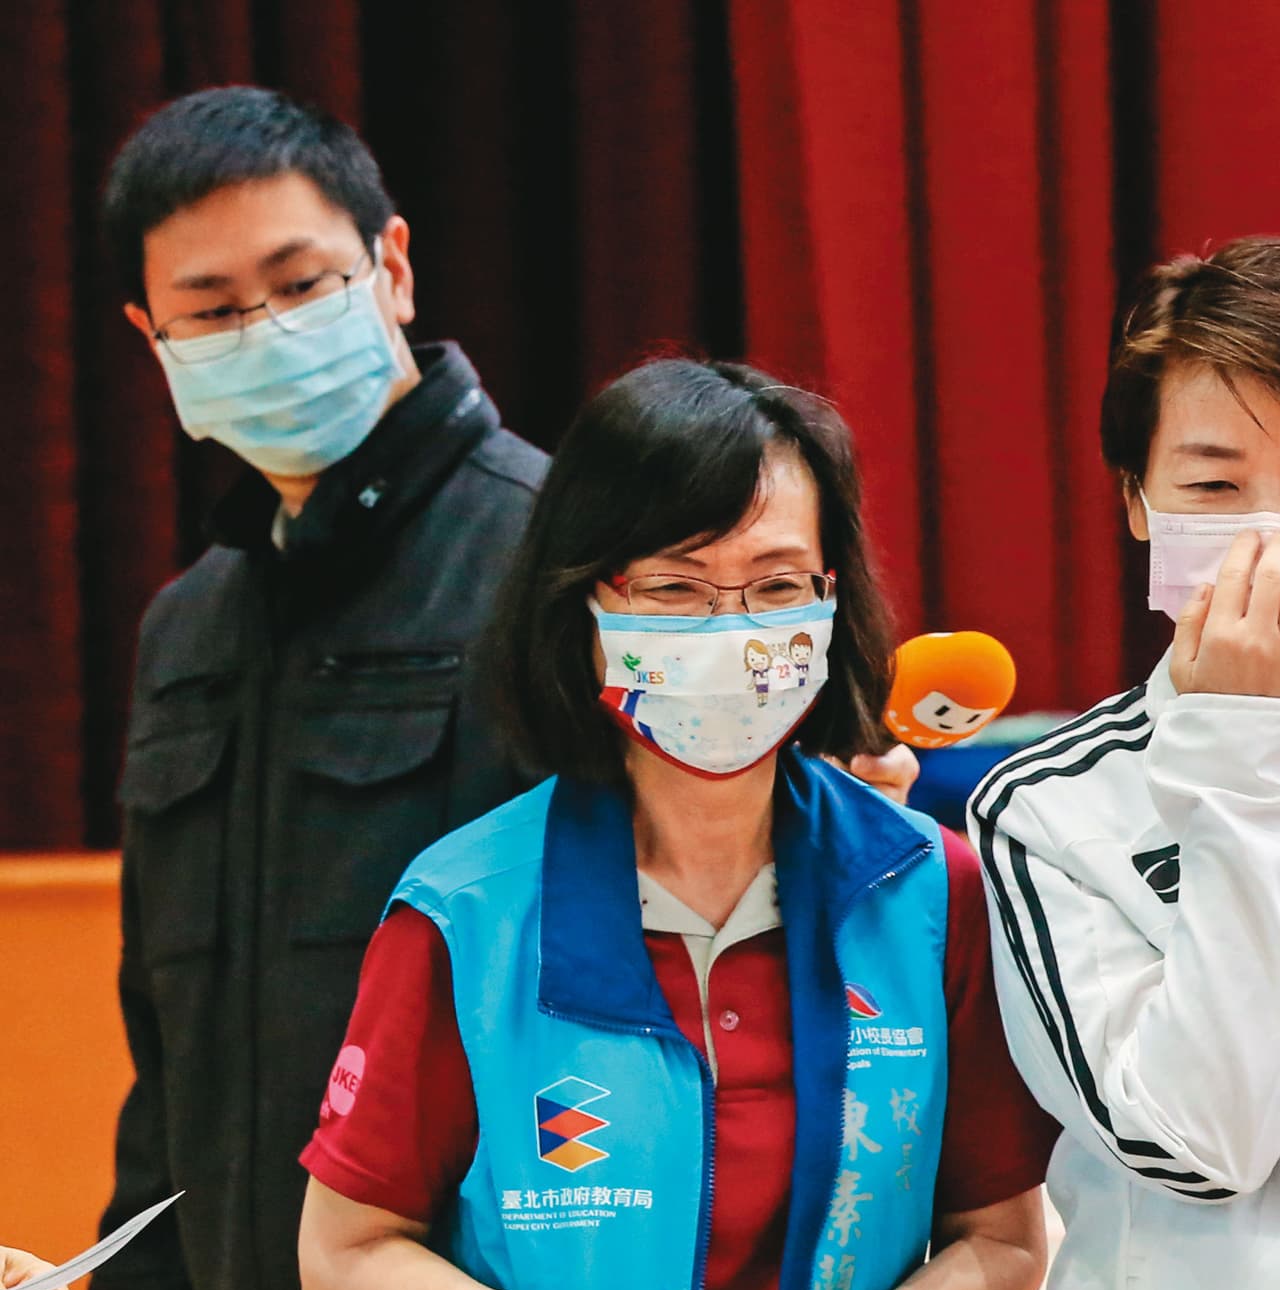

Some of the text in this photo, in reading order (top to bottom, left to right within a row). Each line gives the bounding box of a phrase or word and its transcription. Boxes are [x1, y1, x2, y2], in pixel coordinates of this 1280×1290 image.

[502, 1186, 653, 1209] 臺北市政府教育局
